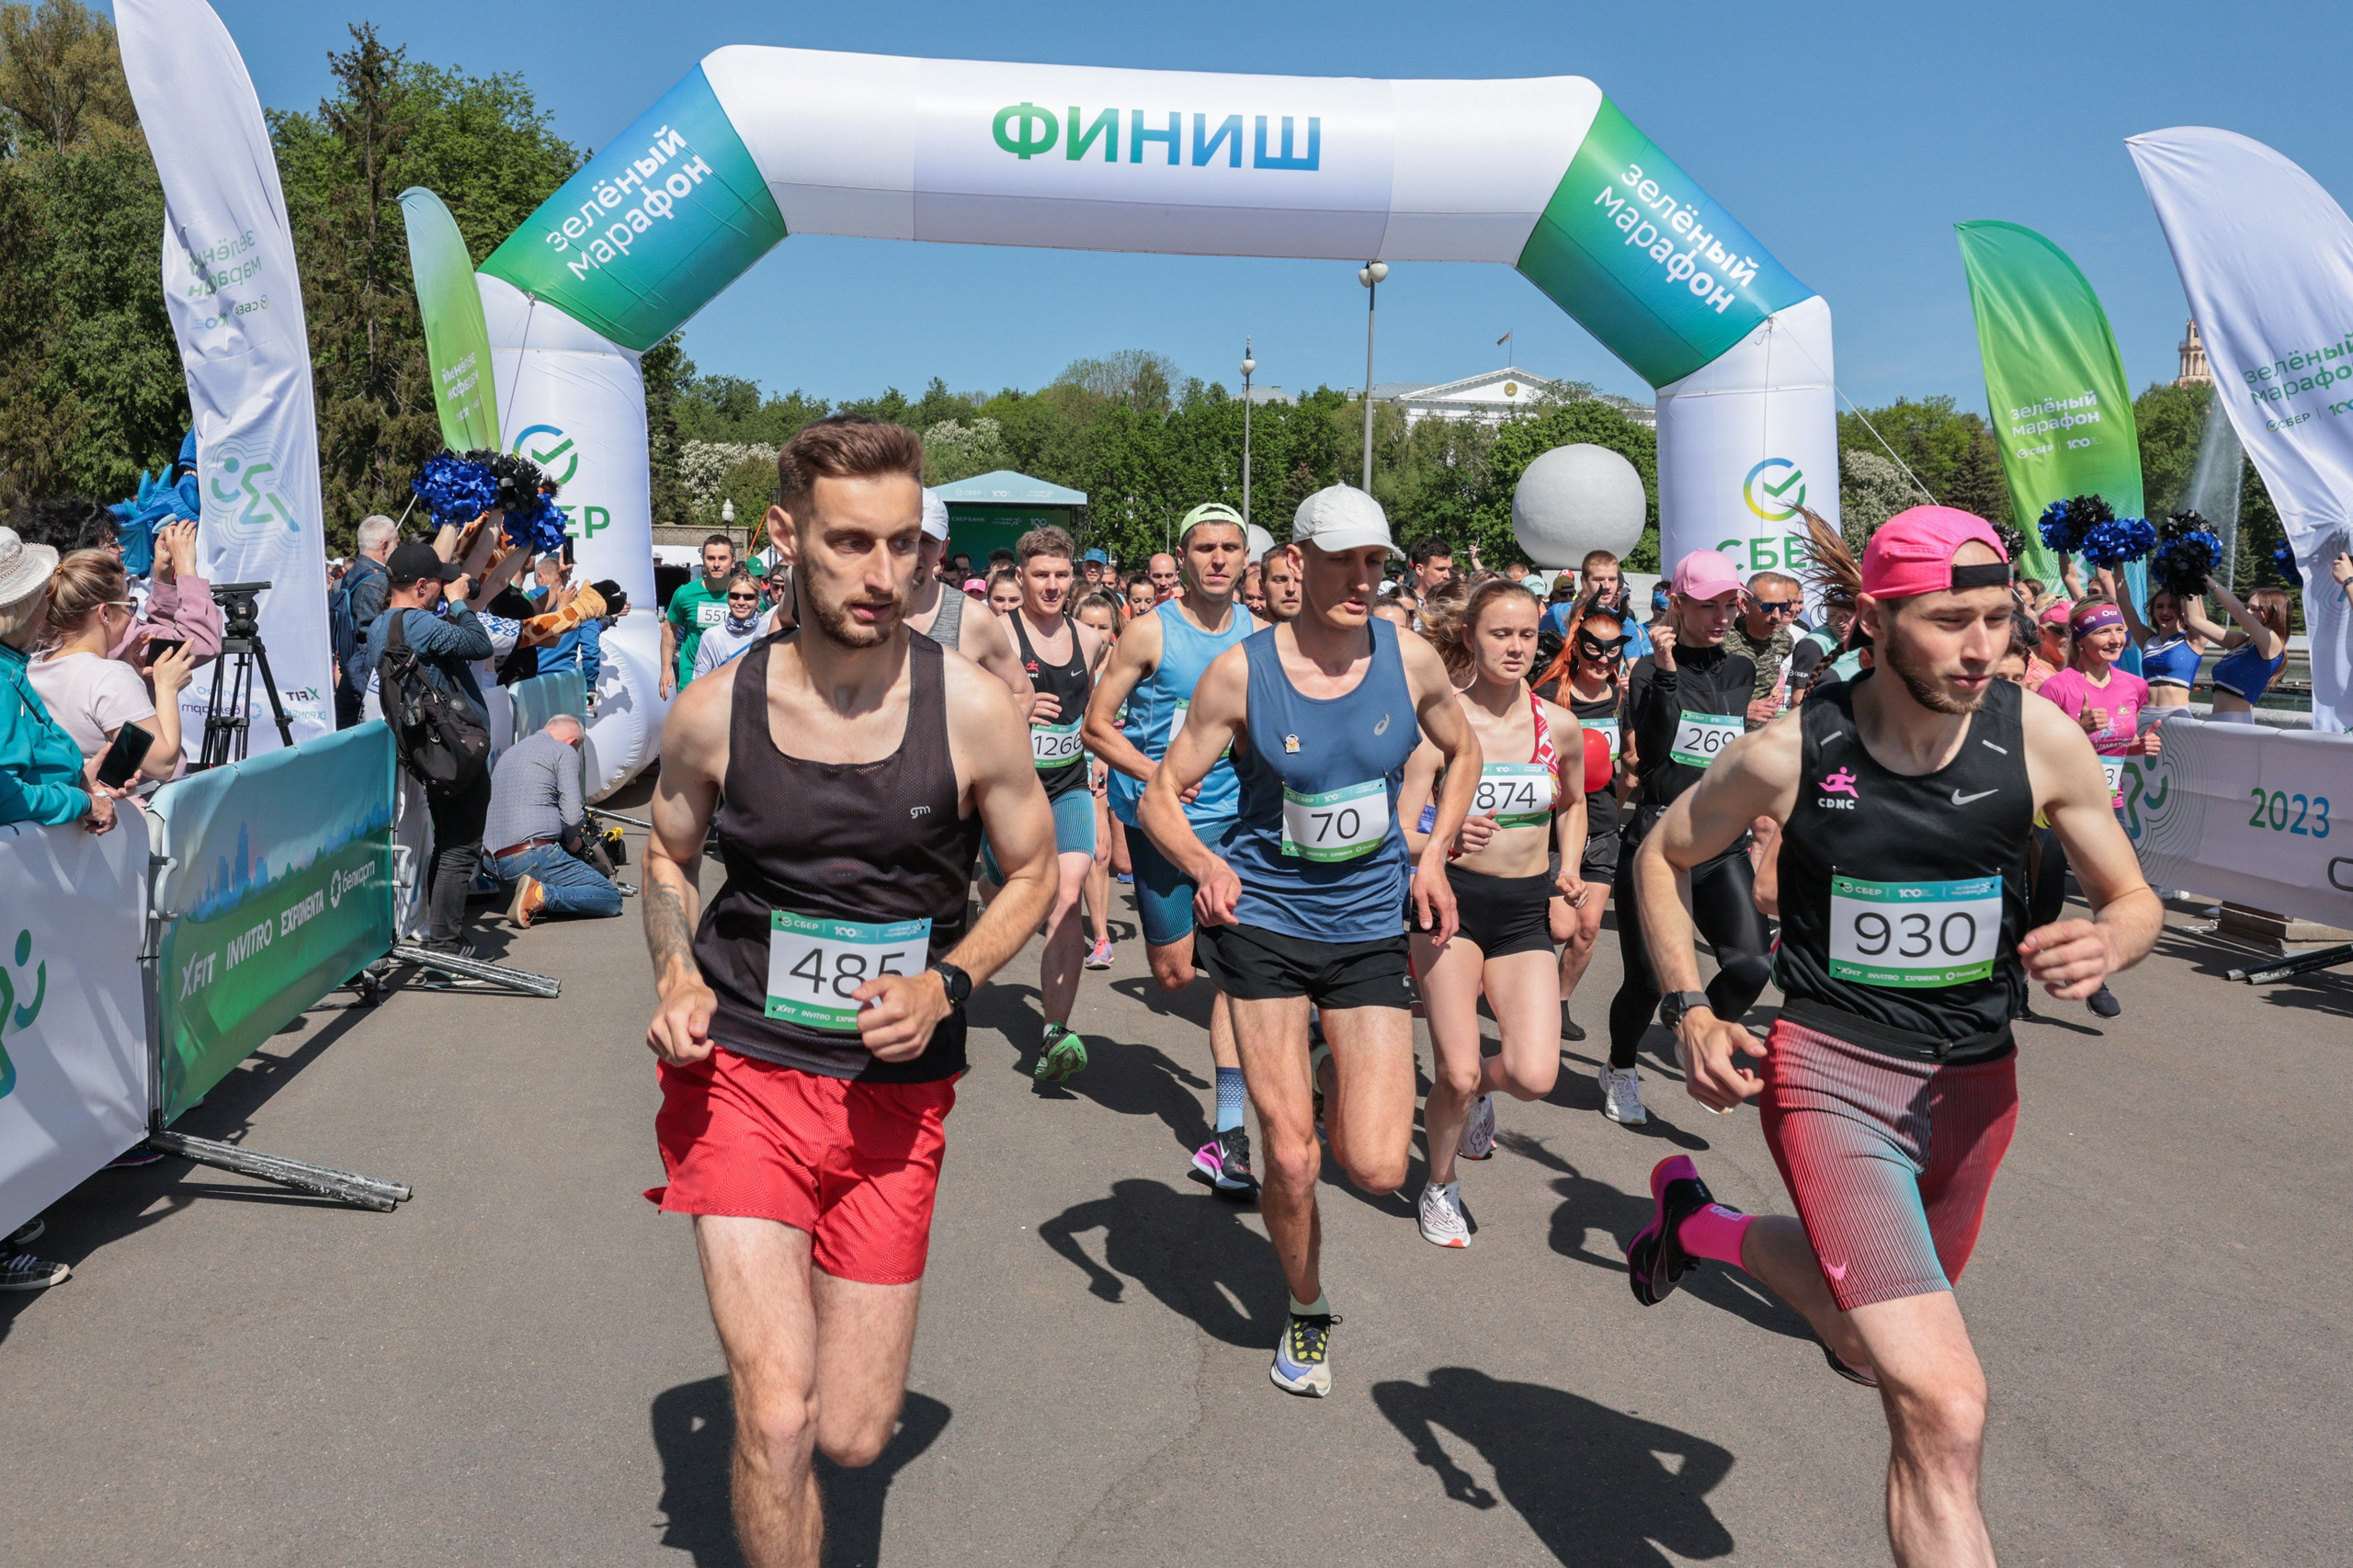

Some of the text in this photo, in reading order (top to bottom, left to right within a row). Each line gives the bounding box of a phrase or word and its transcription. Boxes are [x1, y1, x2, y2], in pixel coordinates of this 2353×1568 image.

[992, 102, 1321, 171] ФИНИШ
[545, 125, 688, 252] зелёный
[566, 154, 713, 281] марафон
[1620, 164, 1759, 288] зелёный
[1594, 186, 1735, 314] марафон
[2251, 366, 2353, 405] марафо
[2010, 390, 2097, 420] зелёный
[2012, 411, 2100, 438] марафон
[2279, 413, 2311, 428] СБЕР
[2029, 437, 2091, 456] СБЕР 100
[556, 506, 610, 539] ЕР
[704, 608, 726, 622] 551
[1034, 733, 1081, 756] 1266
[1476, 782, 1537, 810] 874
[1818, 798, 1855, 810] CDNC
[1311, 808, 1360, 843] 70
[2249, 788, 2330, 839] 2023
[1855, 888, 1882, 896] СБЕР
[1899, 888, 1923, 898] 100
[794, 921, 819, 930] СБЕР
[834, 926, 857, 937] 100
[1854, 912, 1976, 958] 930
[179, 952, 217, 1002] XFIT
[226, 919, 273, 971] INVITRO
[280, 889, 324, 937] EXPONENTA
[1841, 967, 1862, 976] XFIT
[1867, 972, 1900, 981] INVITRO
[777, 1004, 797, 1015] XFIT
[801, 1010, 831, 1021] INVITRO
